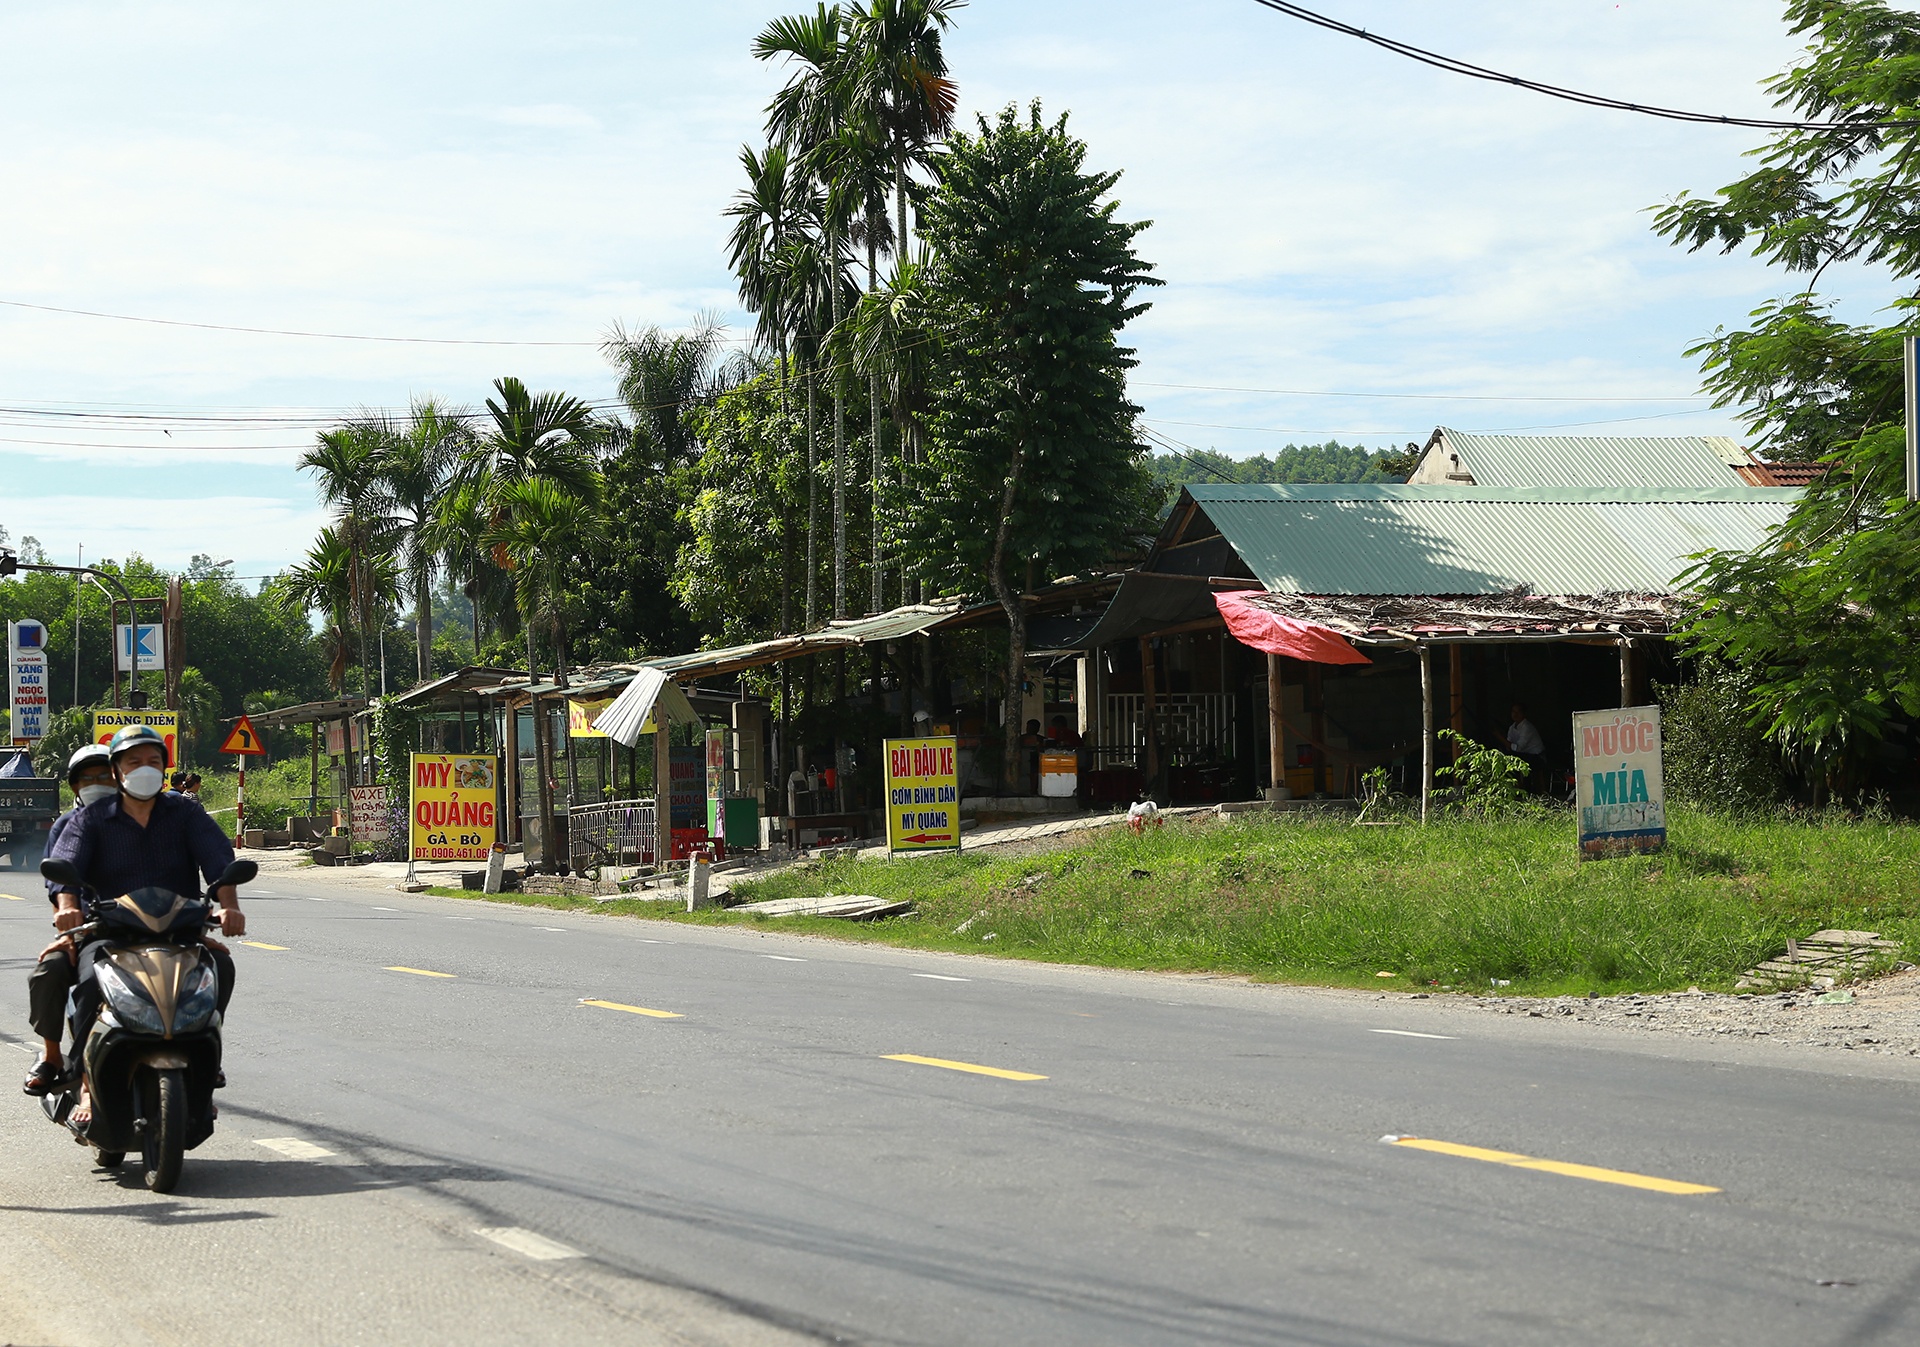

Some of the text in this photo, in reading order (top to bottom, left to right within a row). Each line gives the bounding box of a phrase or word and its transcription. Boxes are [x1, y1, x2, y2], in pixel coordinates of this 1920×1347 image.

[15, 695, 47, 705] KHÁNH
[17, 686, 43, 696] NGỌC
[20, 707, 42, 715] NAM
[97, 713, 141, 725] HOÀNG
[1583, 716, 1653, 757] NƯỚC
[416, 756, 452, 789] MỲ
[892, 744, 953, 781] BÃI ĐẬU XE
[892, 784, 955, 805] CƠM BÌNH DÂN
[1593, 763, 1649, 805] MÍA
[416, 792, 494, 831] QUẢNG
[902, 809, 947, 830] MỲ QUẢNG
[427, 833, 448, 845] GÀ
[460, 832, 482, 845] BÒ
